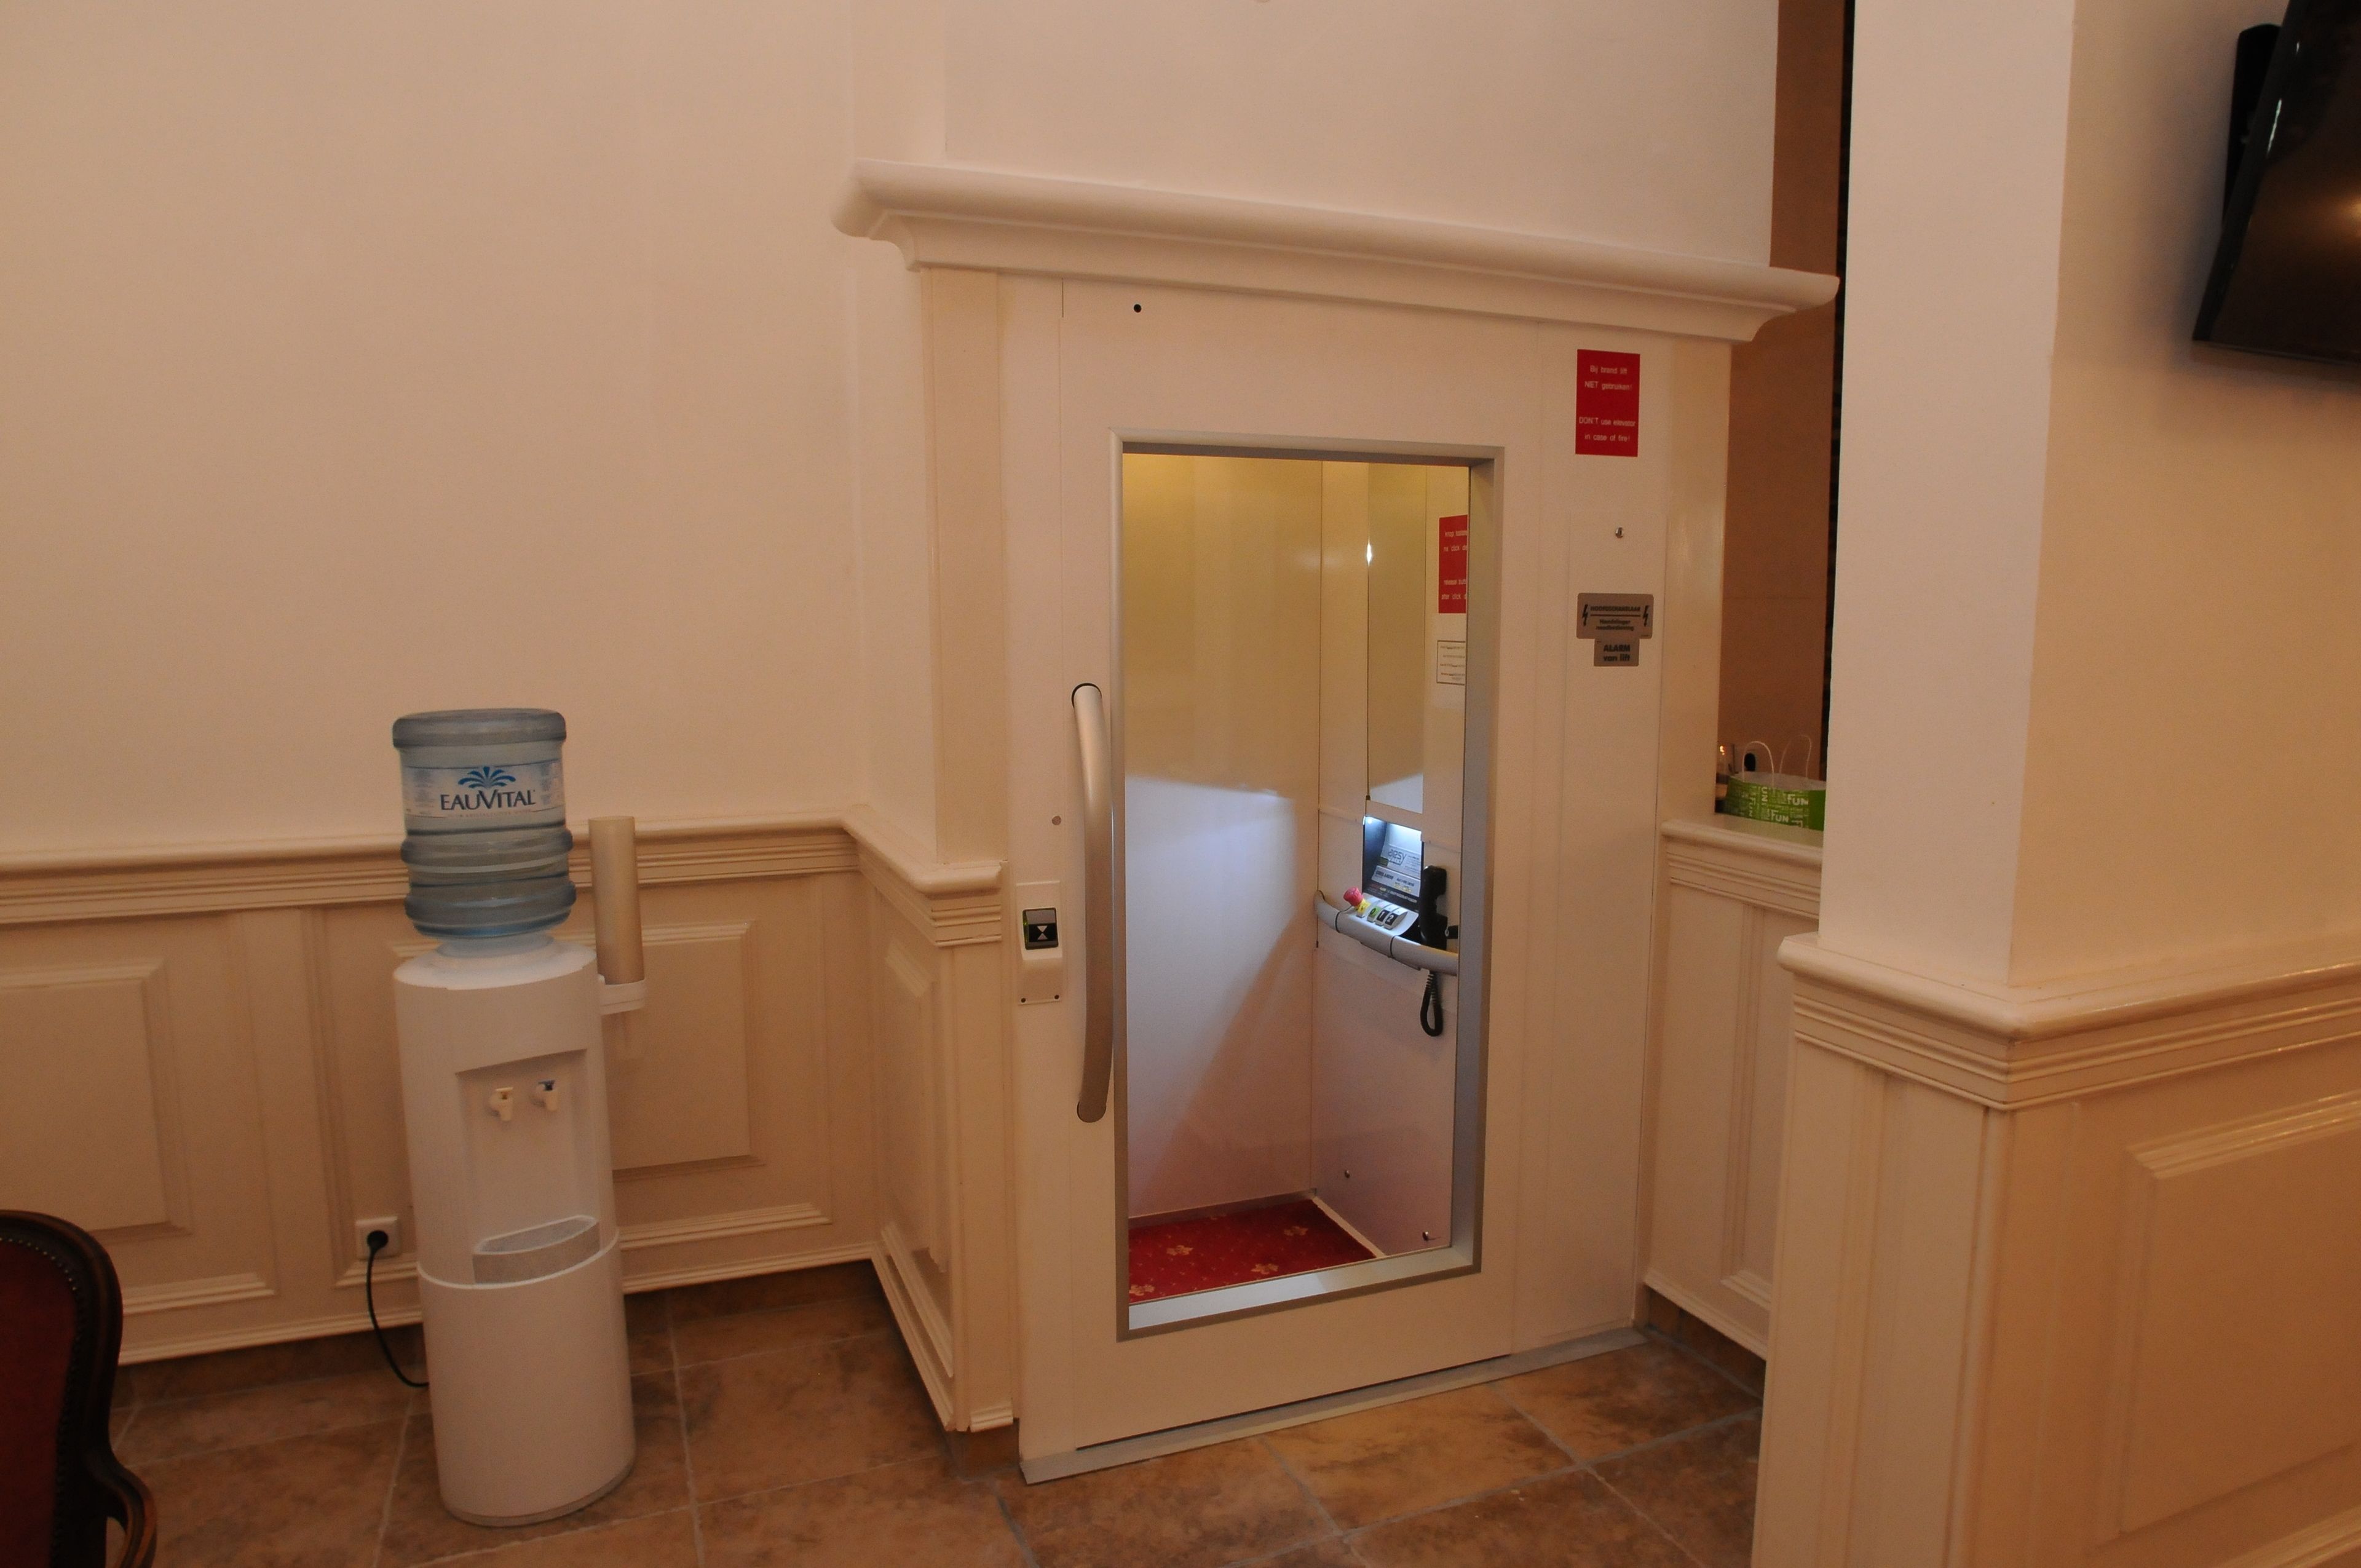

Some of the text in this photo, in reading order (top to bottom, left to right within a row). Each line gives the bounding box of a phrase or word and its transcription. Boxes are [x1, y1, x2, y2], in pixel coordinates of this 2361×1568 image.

[440, 789, 536, 810] EAUVITAL
[1787, 794, 1809, 806] FUN
[1771, 809, 1789, 823] FUN
